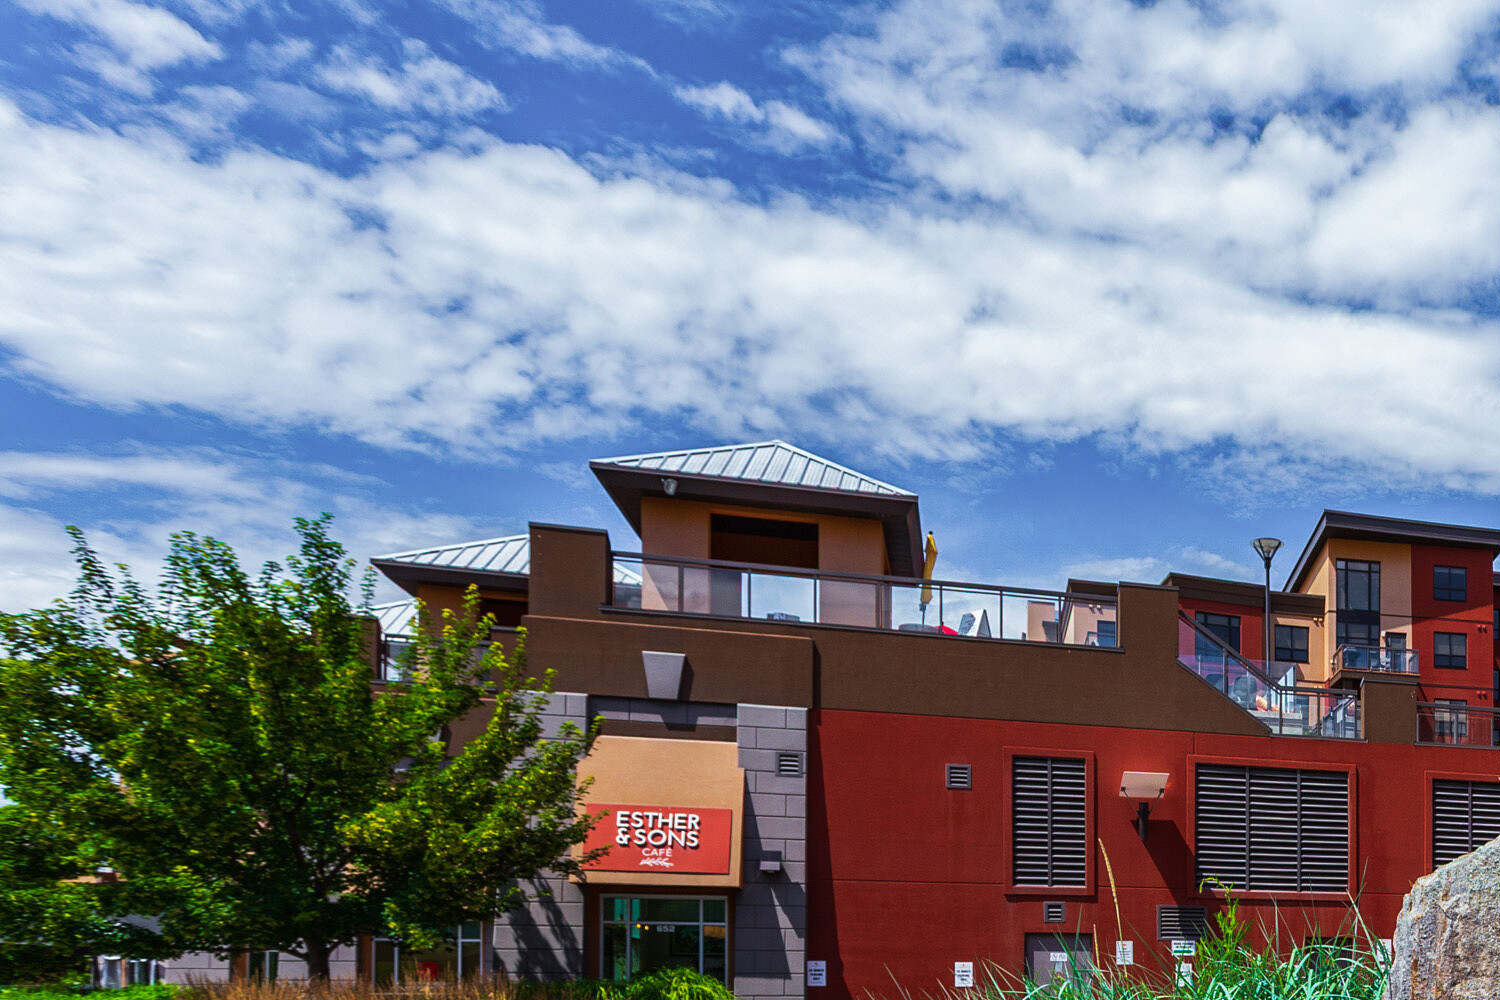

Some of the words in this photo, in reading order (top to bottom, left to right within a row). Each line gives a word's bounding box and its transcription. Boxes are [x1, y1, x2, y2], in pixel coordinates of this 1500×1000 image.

[616, 811, 700, 830] ESTHER
[615, 827, 631, 845] &
[634, 829, 699, 847] SONS
[641, 847, 673, 857] CAFÉ
[656, 925, 675, 933] 652
